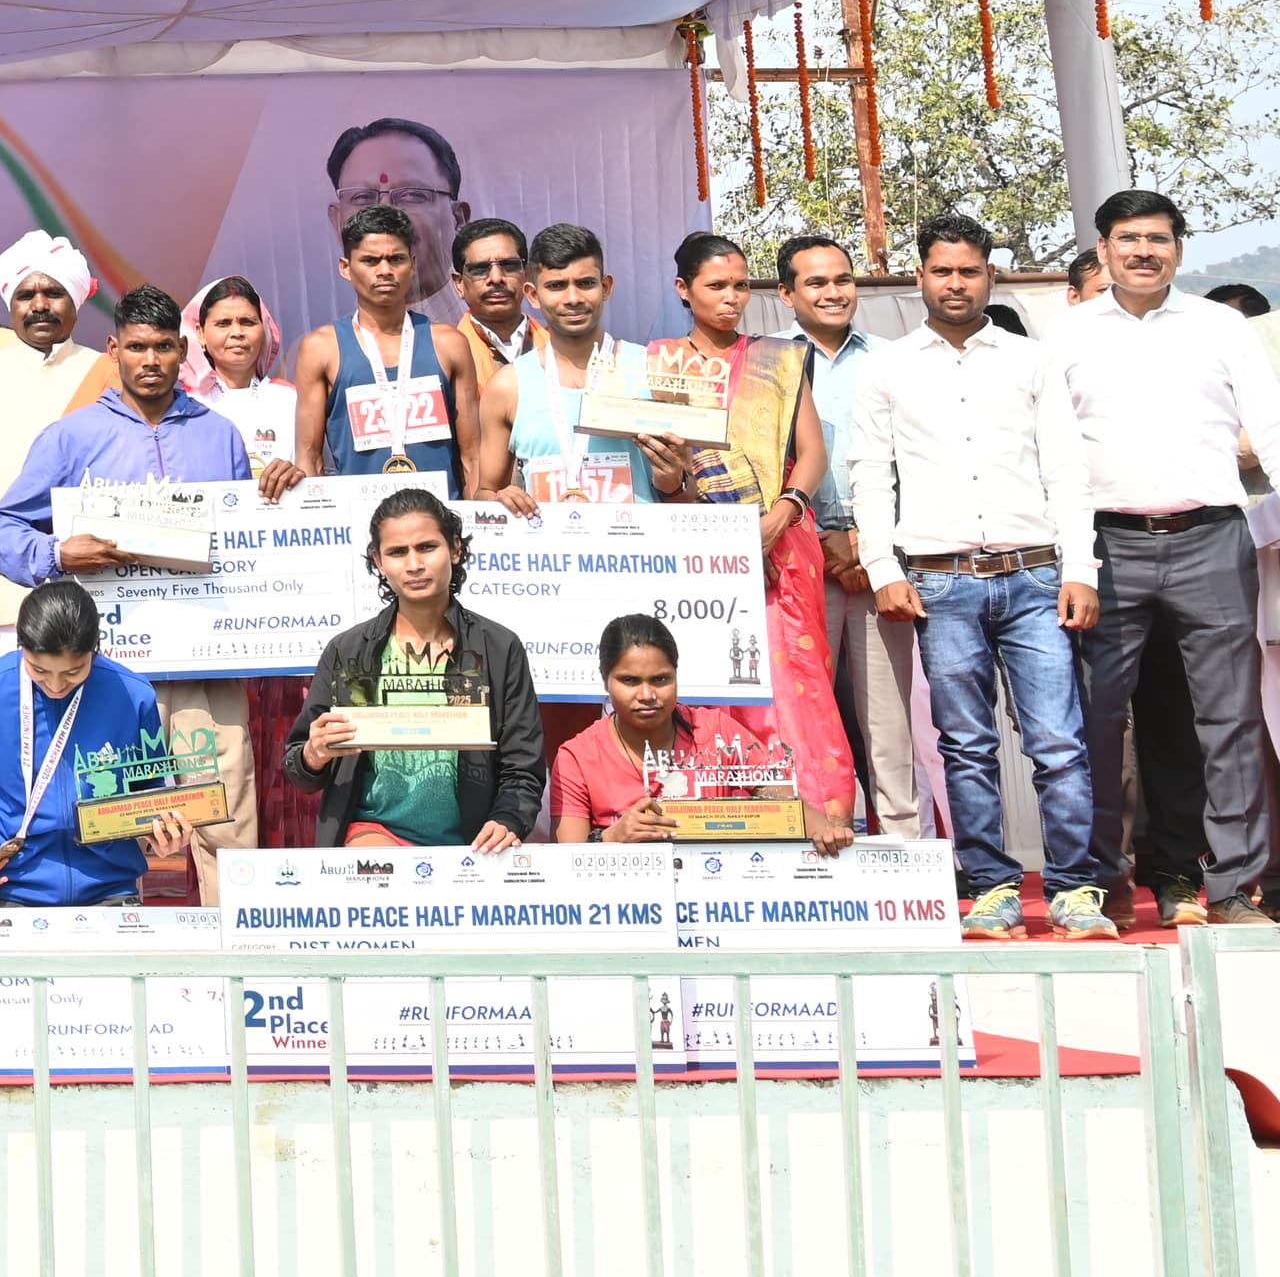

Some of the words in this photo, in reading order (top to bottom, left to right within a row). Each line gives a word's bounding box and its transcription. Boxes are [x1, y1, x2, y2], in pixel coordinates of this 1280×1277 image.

[224, 529, 267, 549] HALF
[467, 552, 521, 572] PEACE
[528, 553, 572, 573] HALF
[578, 554, 677, 574] MARATHON
[683, 555, 704, 574] 10
[710, 555, 750, 575] KMS
[116, 584, 167, 600] Seventy
[172, 582, 199, 596] Five
[203, 580, 267, 596] Thousand
[272, 579, 304, 595] Only
[469, 582, 562, 597] CATEGORY
[653, 597, 749, 624] 8,000/-
[213, 614, 342, 632] #RUNFORMAAD
[98, 630, 152, 646] Place
[98, 647, 152, 659] Winner
[448, 694, 472, 705] 2025
[236, 907, 341, 928] ABUJHMAD
[348, 906, 409, 927] PEACE
[416, 905, 464, 927] HALF
[471, 904, 582, 926] MARATHON
[589, 903, 611, 925] 21
[618, 903, 663, 925] KMS
[705, 901, 755, 923] HALF
[762, 900, 869, 922] MARATHON
[875, 899, 897, 921] 10
[904, 899, 946, 921] KMS
[50, 994, 84, 1007] Only
